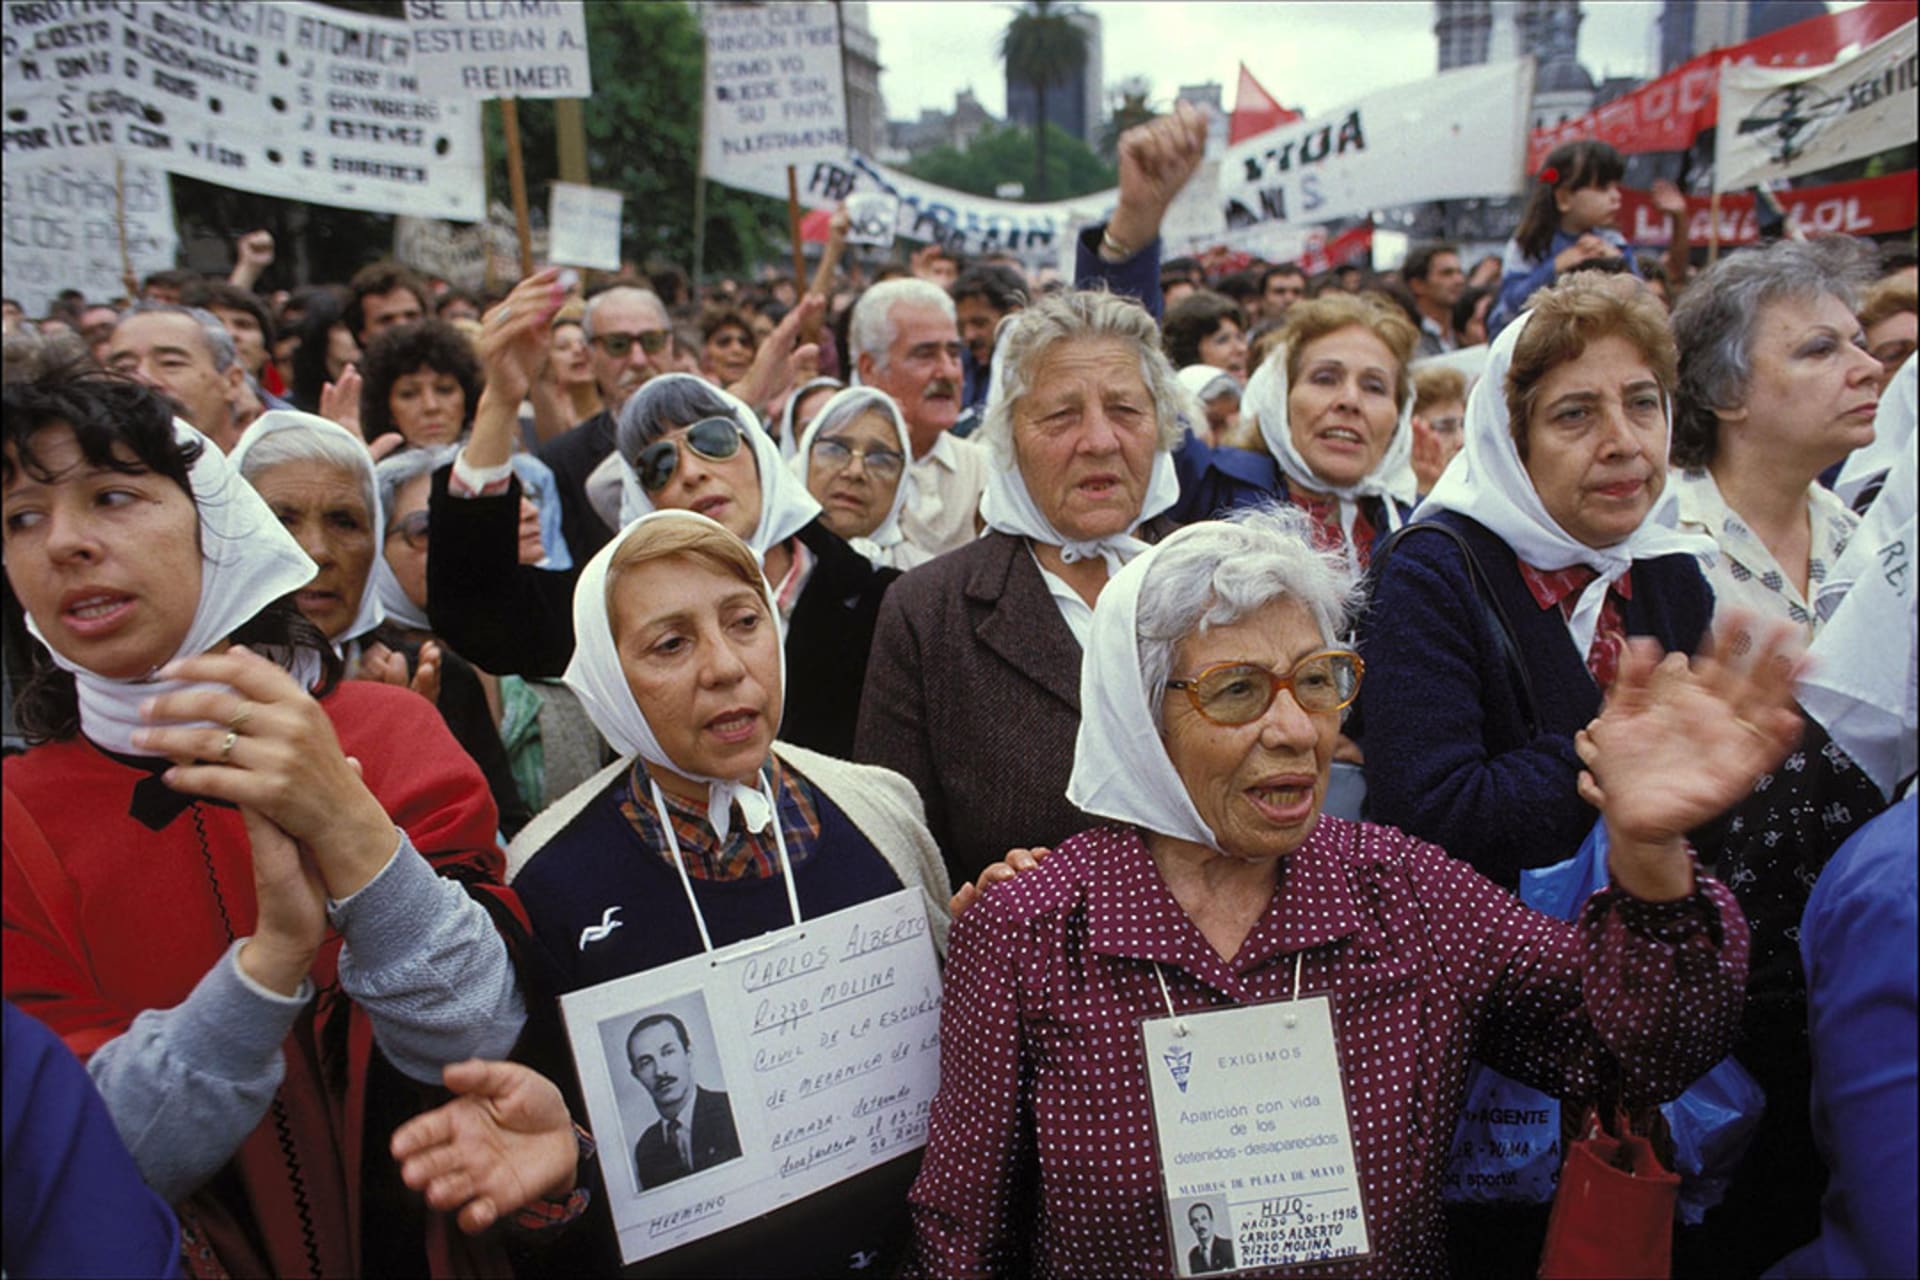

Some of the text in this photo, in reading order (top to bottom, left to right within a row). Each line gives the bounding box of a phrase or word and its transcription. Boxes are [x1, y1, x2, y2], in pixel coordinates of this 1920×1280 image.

[411, 1, 562, 21] SE LLAMA
[413, 29, 545, 52] ESTEBAN
[462, 66, 573, 90] REIMER
[743, 917, 926, 991] CARLOS ALBERTO
[1218, 1047, 1302, 1069] EXIGIMOS
[1180, 1095, 1321, 1126] Aparición con vida
[1230, 1119, 1276, 1136] de los
[1231, 1178, 1244, 1190] DE
[1250, 1174, 1286, 1187] PLAZA
[1291, 1170, 1305, 1181] DE
[1311, 1165, 1345, 1179] MAYO
[1240, 1223, 1344, 1243] CARLOS ALBERTO
[1241, 1216, 1287, 1231] NACIDO
[1241, 1238, 1332, 1256] RIZZO MOLINA
